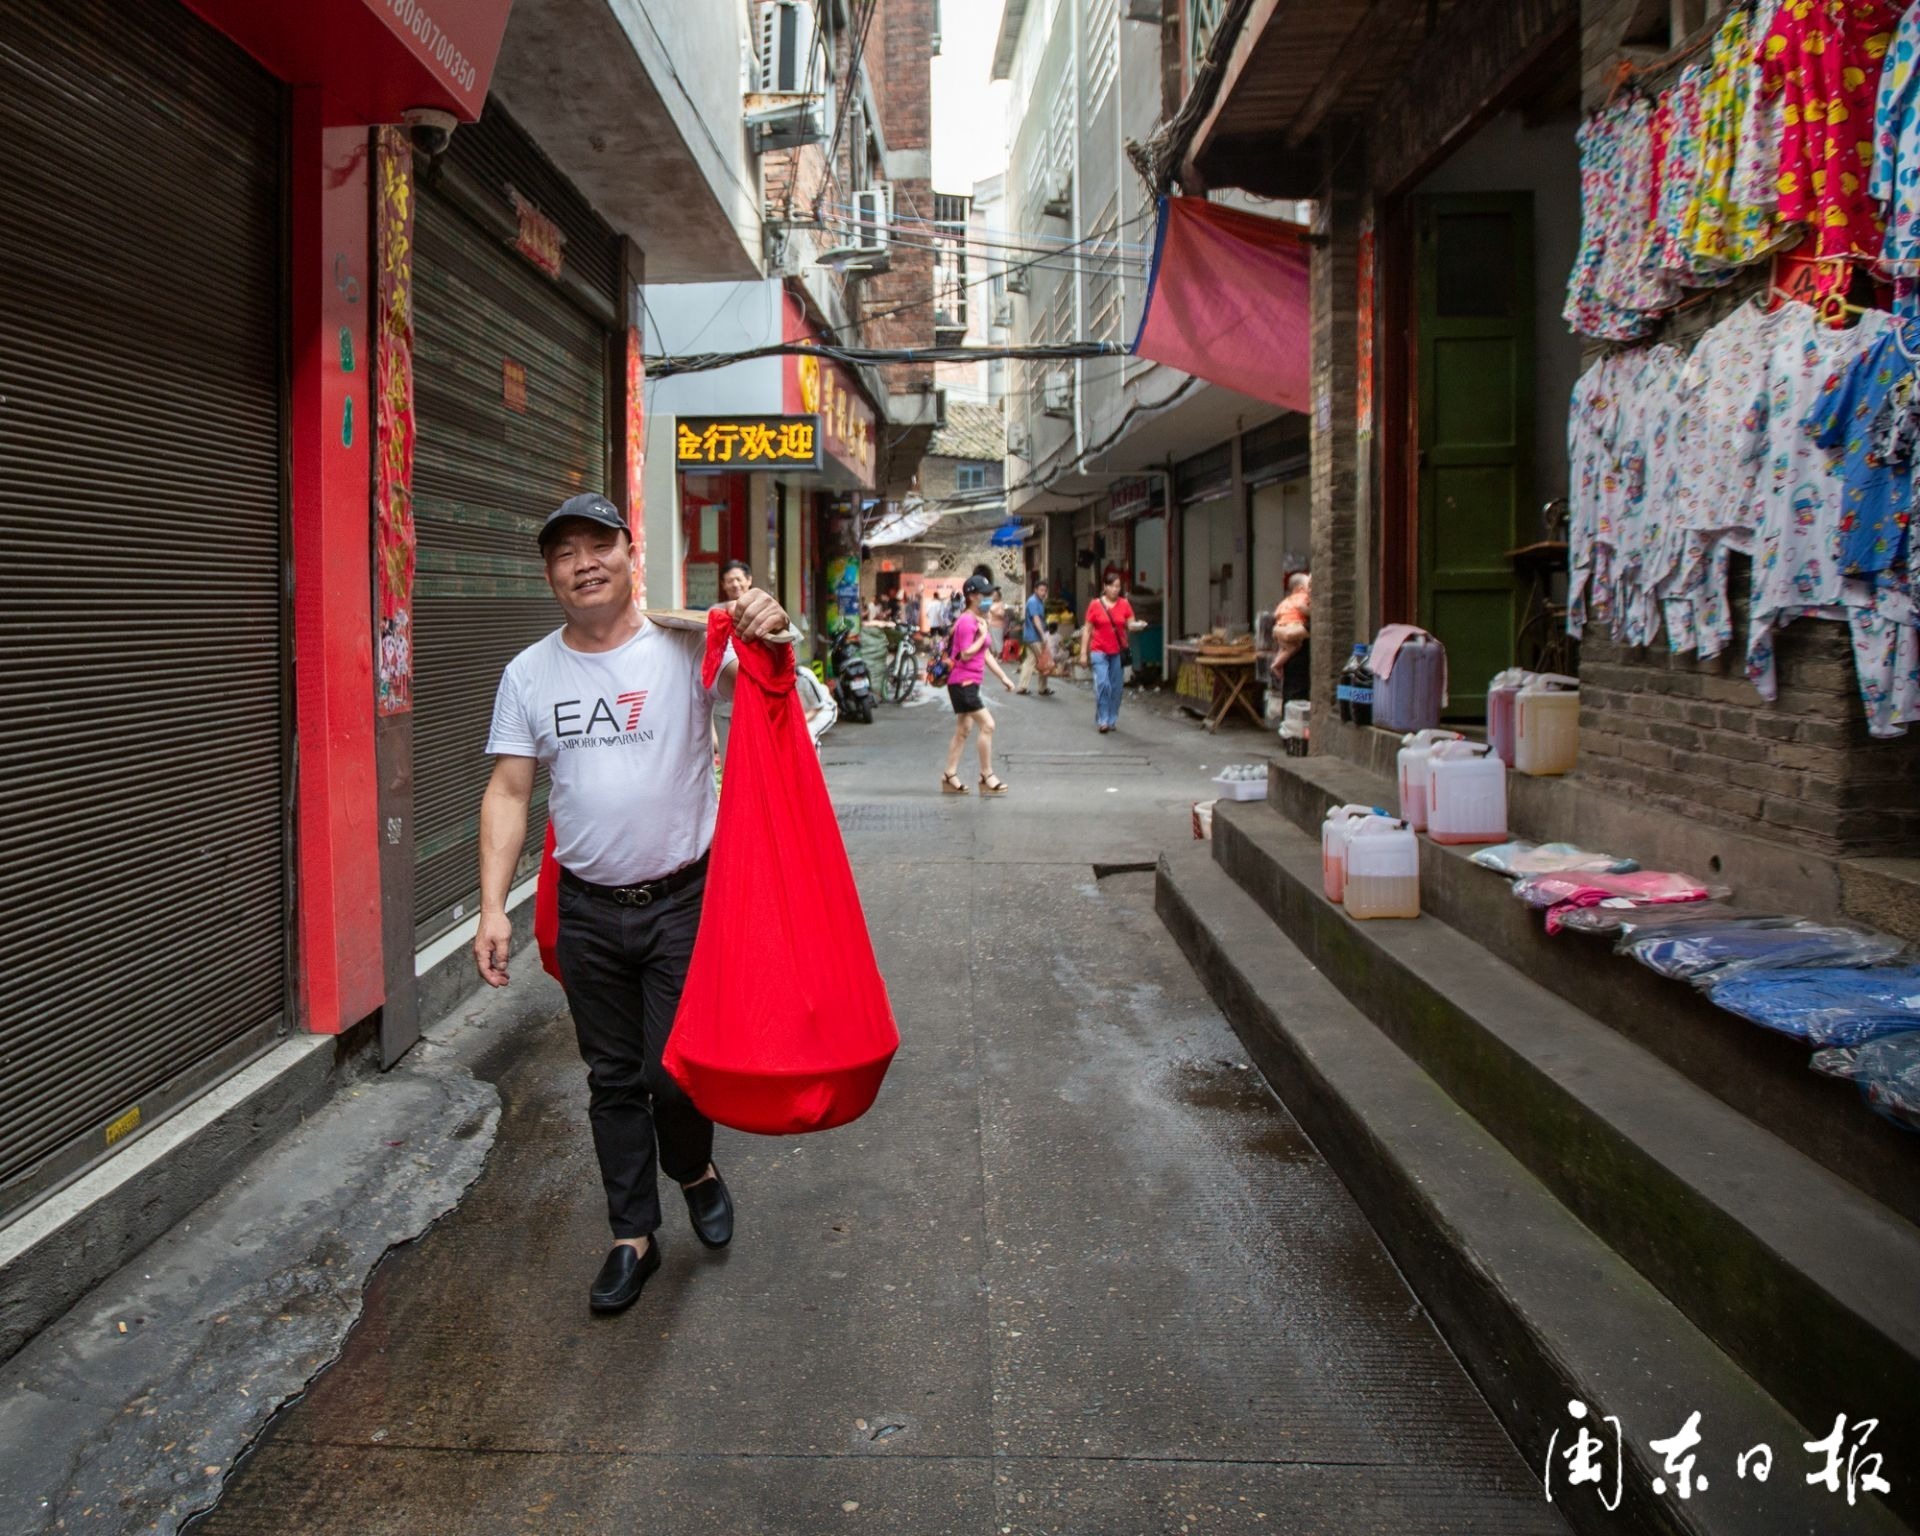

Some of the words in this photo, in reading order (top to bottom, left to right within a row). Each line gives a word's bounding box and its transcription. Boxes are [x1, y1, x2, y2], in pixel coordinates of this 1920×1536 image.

[386, 0, 476, 92] 8060700350
[677, 422, 815, 462] 金行欢迎
[554, 690, 649, 737] EA7
[557, 737, 603, 752] EMPORIO
[618, 730, 654, 747] ARMANI
